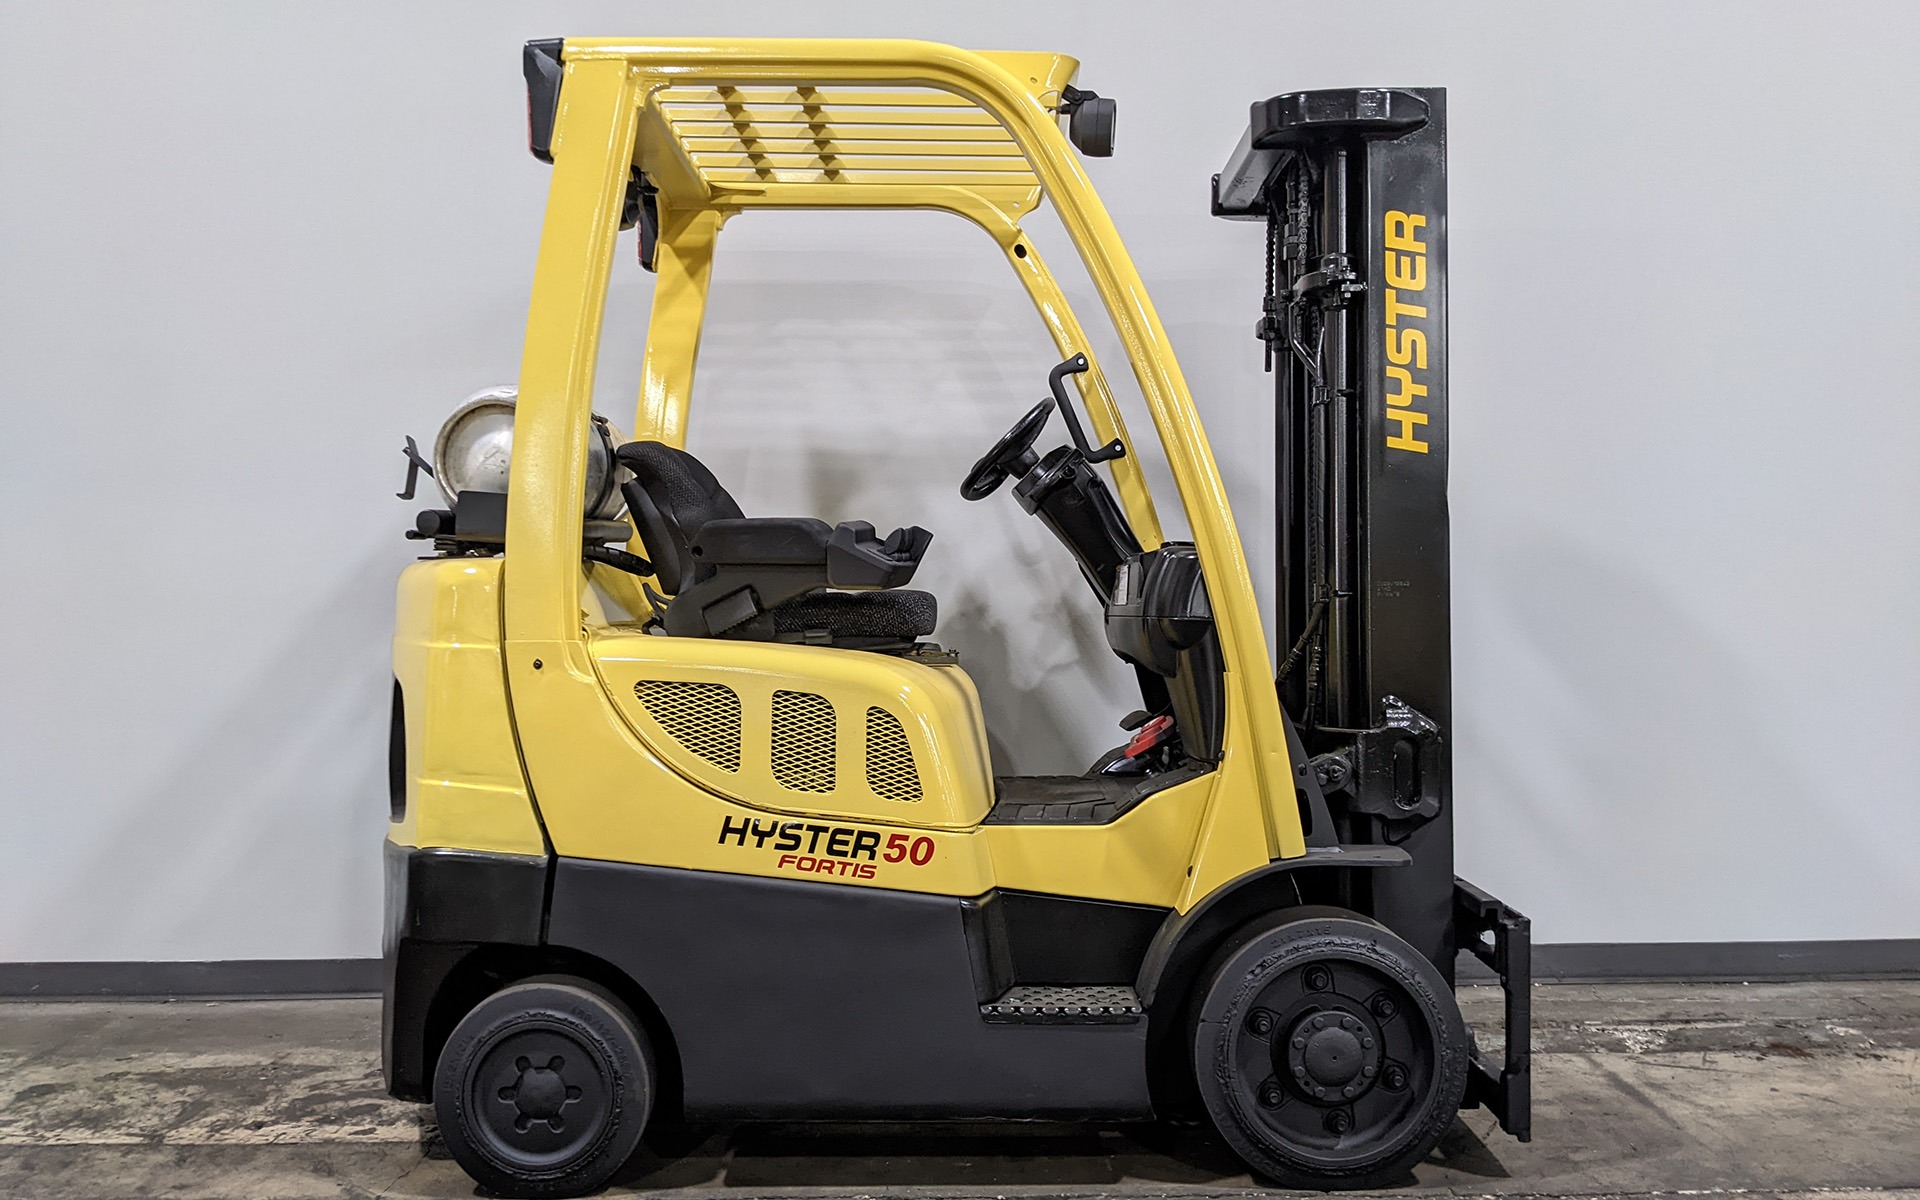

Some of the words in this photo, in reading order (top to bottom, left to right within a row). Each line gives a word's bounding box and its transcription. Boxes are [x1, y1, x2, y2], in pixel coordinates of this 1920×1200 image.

[1384, 210, 1429, 454] HYSTER
[718, 815, 881, 861] HYSTER
[883, 833, 935, 866] 50
[777, 854, 877, 879] FORTIS
